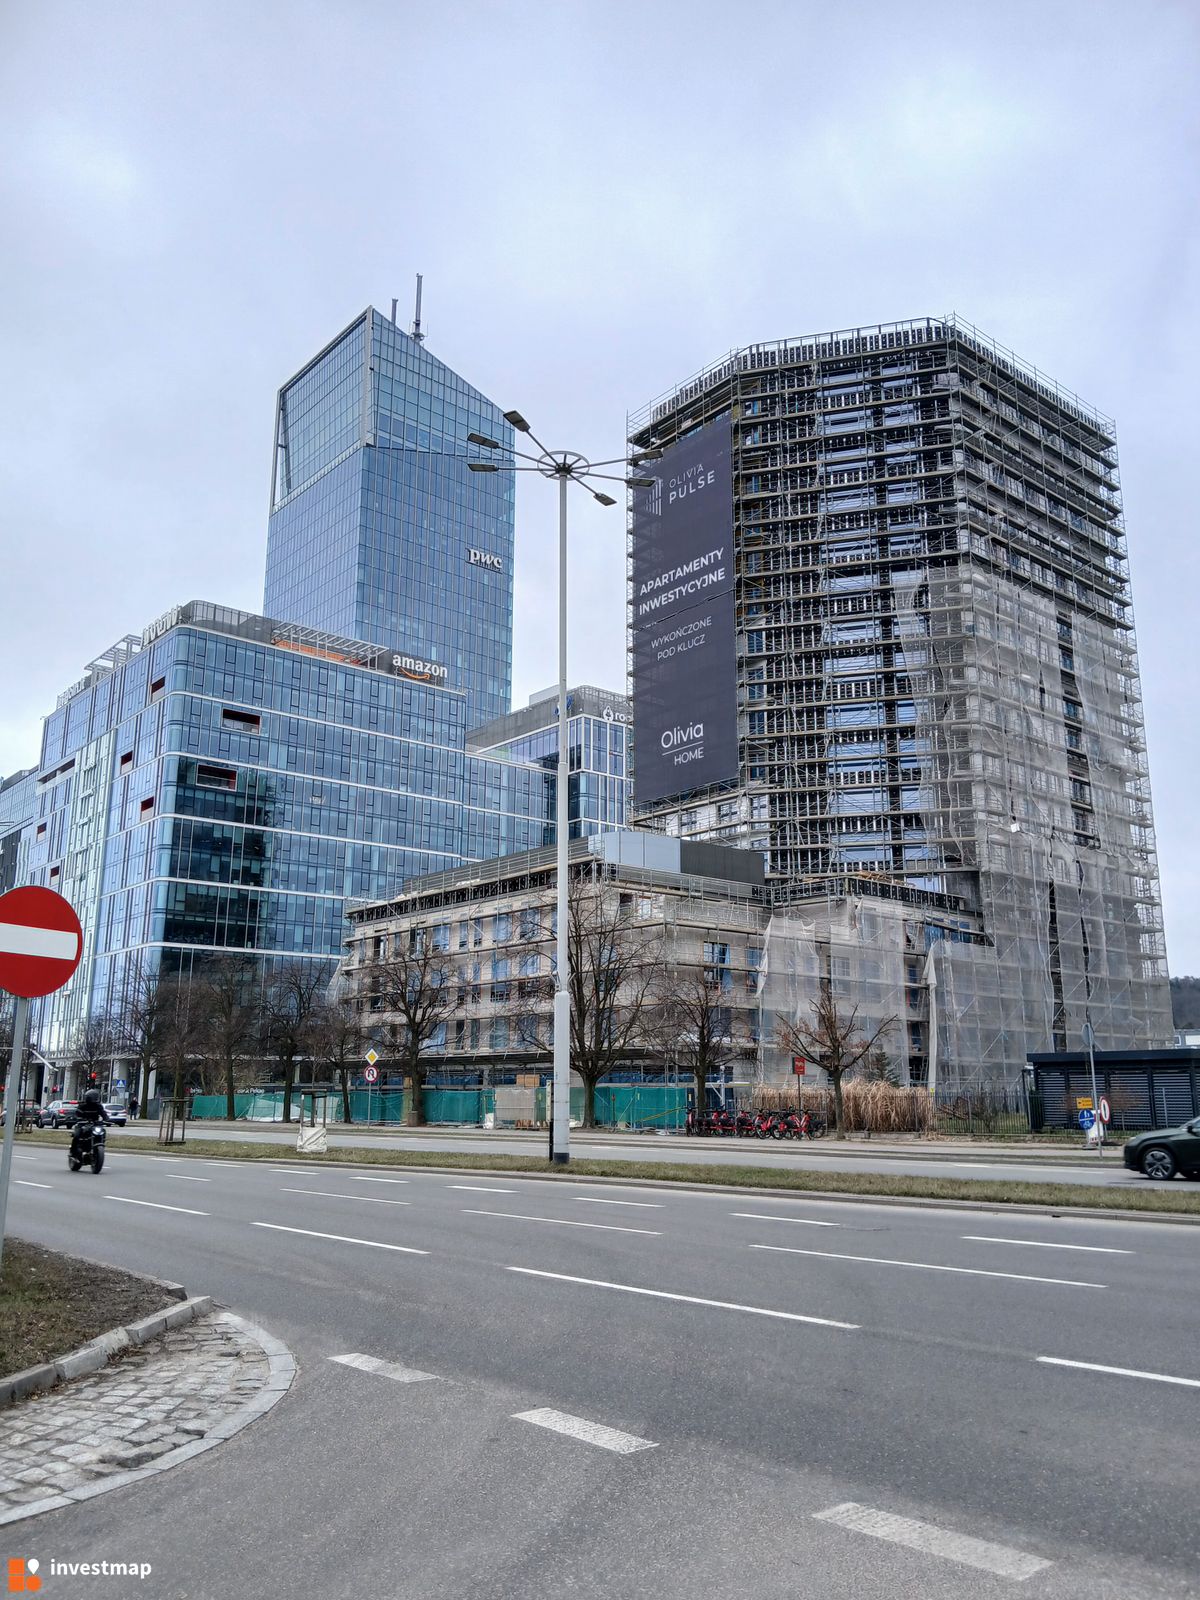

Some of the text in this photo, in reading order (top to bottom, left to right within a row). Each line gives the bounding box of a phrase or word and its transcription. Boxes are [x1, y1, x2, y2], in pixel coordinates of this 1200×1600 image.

[669, 463, 704, 488] OLIVIA
[669, 470, 715, 504] PULSE
[469, 549, 503, 569] pwc
[640, 547, 724, 596] APARTAMENTY
[639, 567, 726, 616] INWESTYCYJNE
[651, 616, 712, 648] WYKOŃCZONE
[657, 634, 706, 661] POD KLUCZ
[392, 654, 448, 678] amazon
[661, 722, 704, 748] Olivia
[674, 746, 704, 766] HOME
